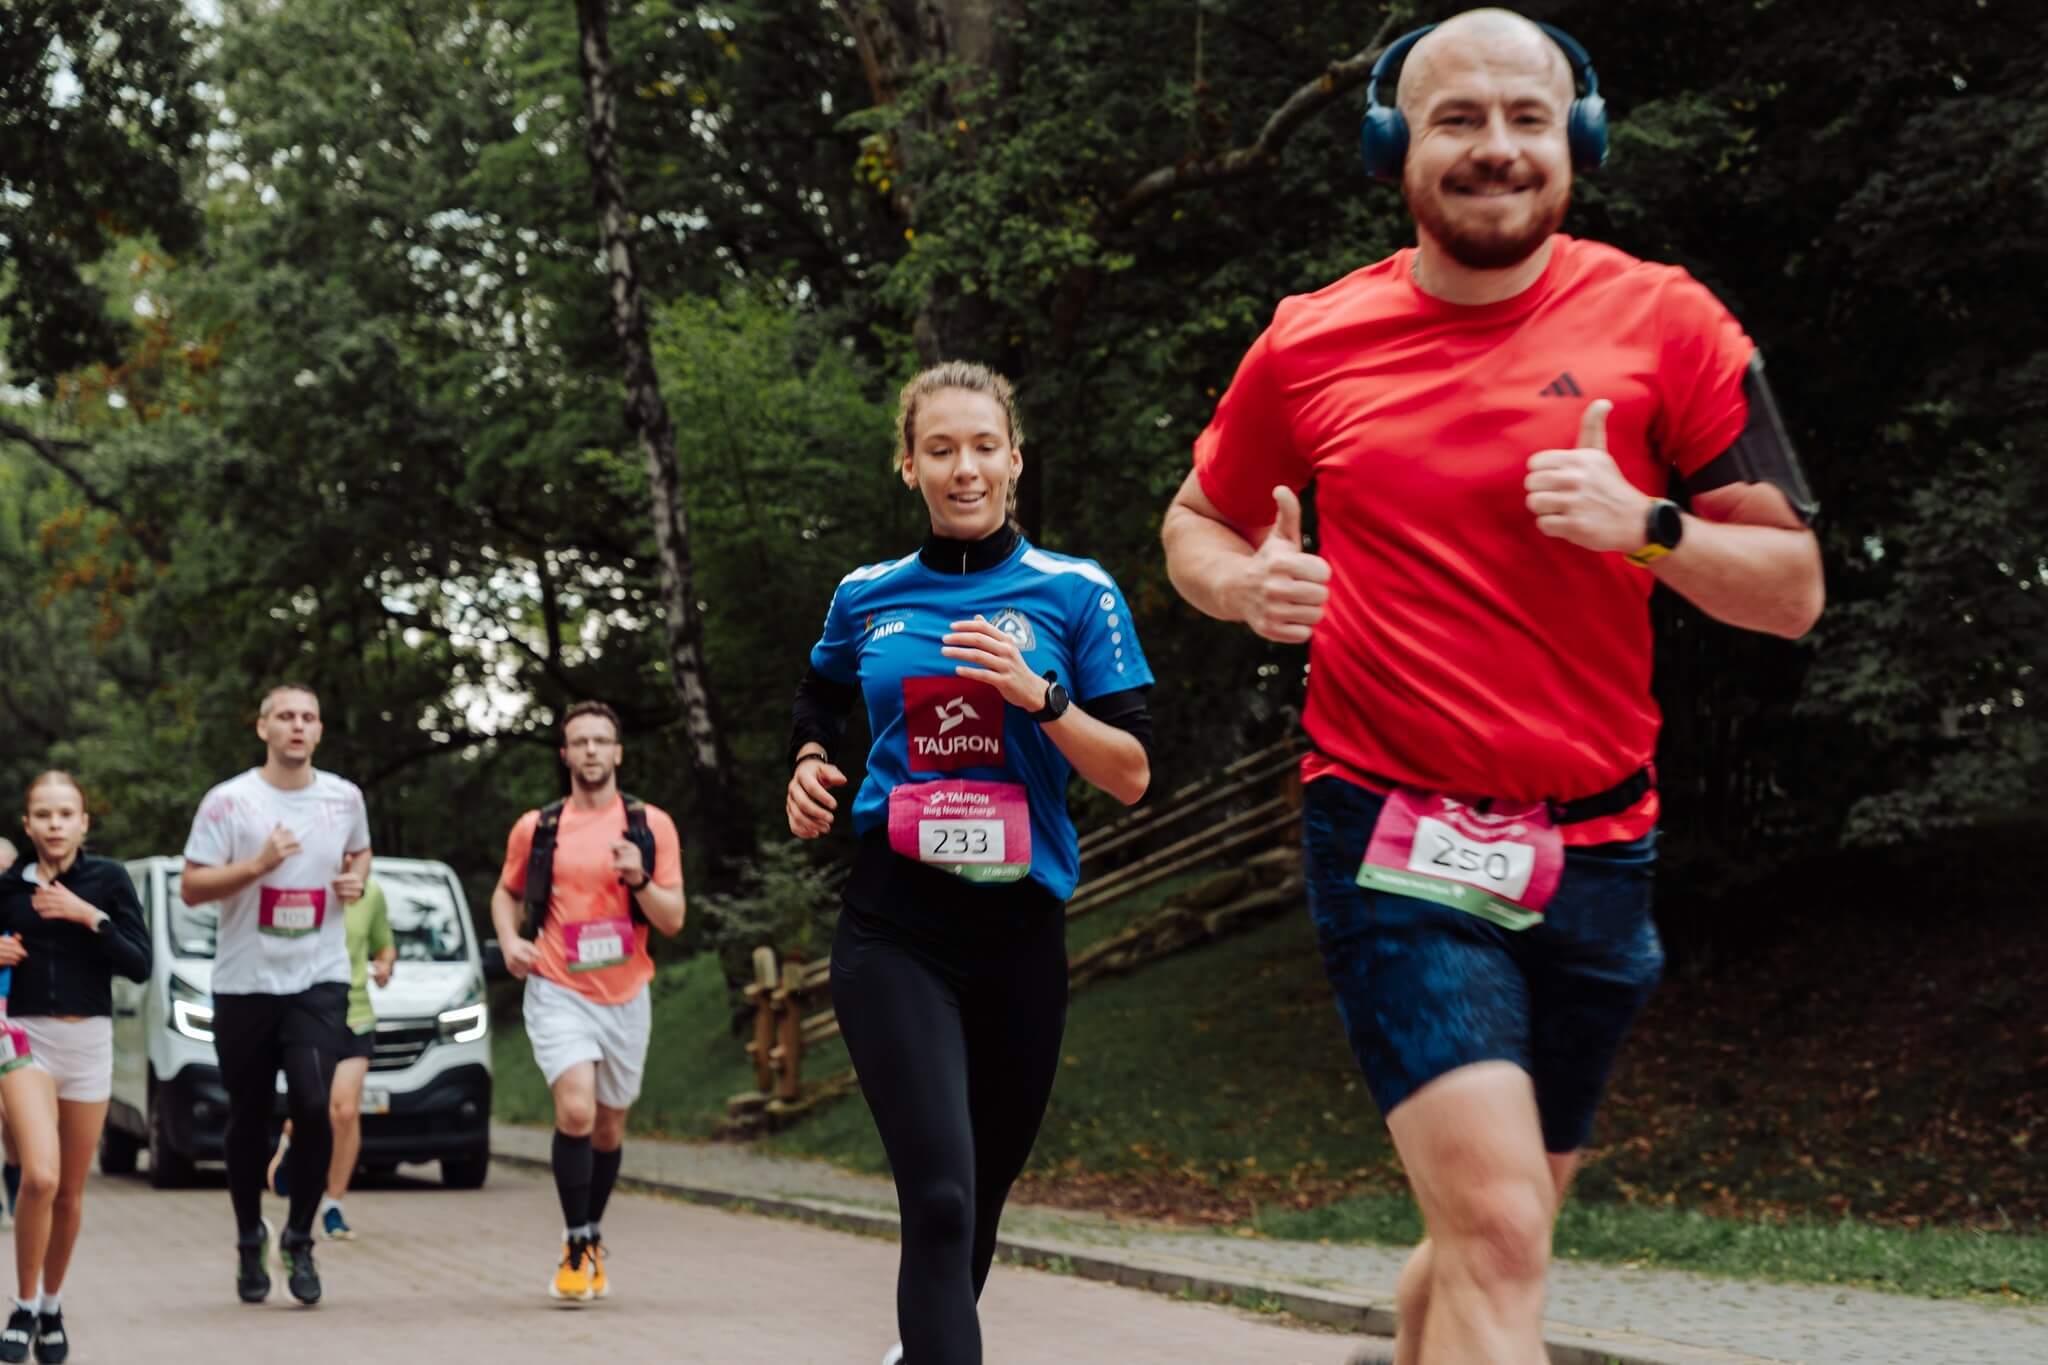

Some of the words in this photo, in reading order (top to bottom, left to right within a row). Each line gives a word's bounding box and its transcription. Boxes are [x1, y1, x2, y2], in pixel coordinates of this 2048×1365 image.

[872, 621, 905, 642] JAKO
[914, 735, 999, 755] TAURON
[946, 791, 990, 806] TAURON
[933, 828, 988, 855] 233
[1432, 834, 1510, 882] 250
